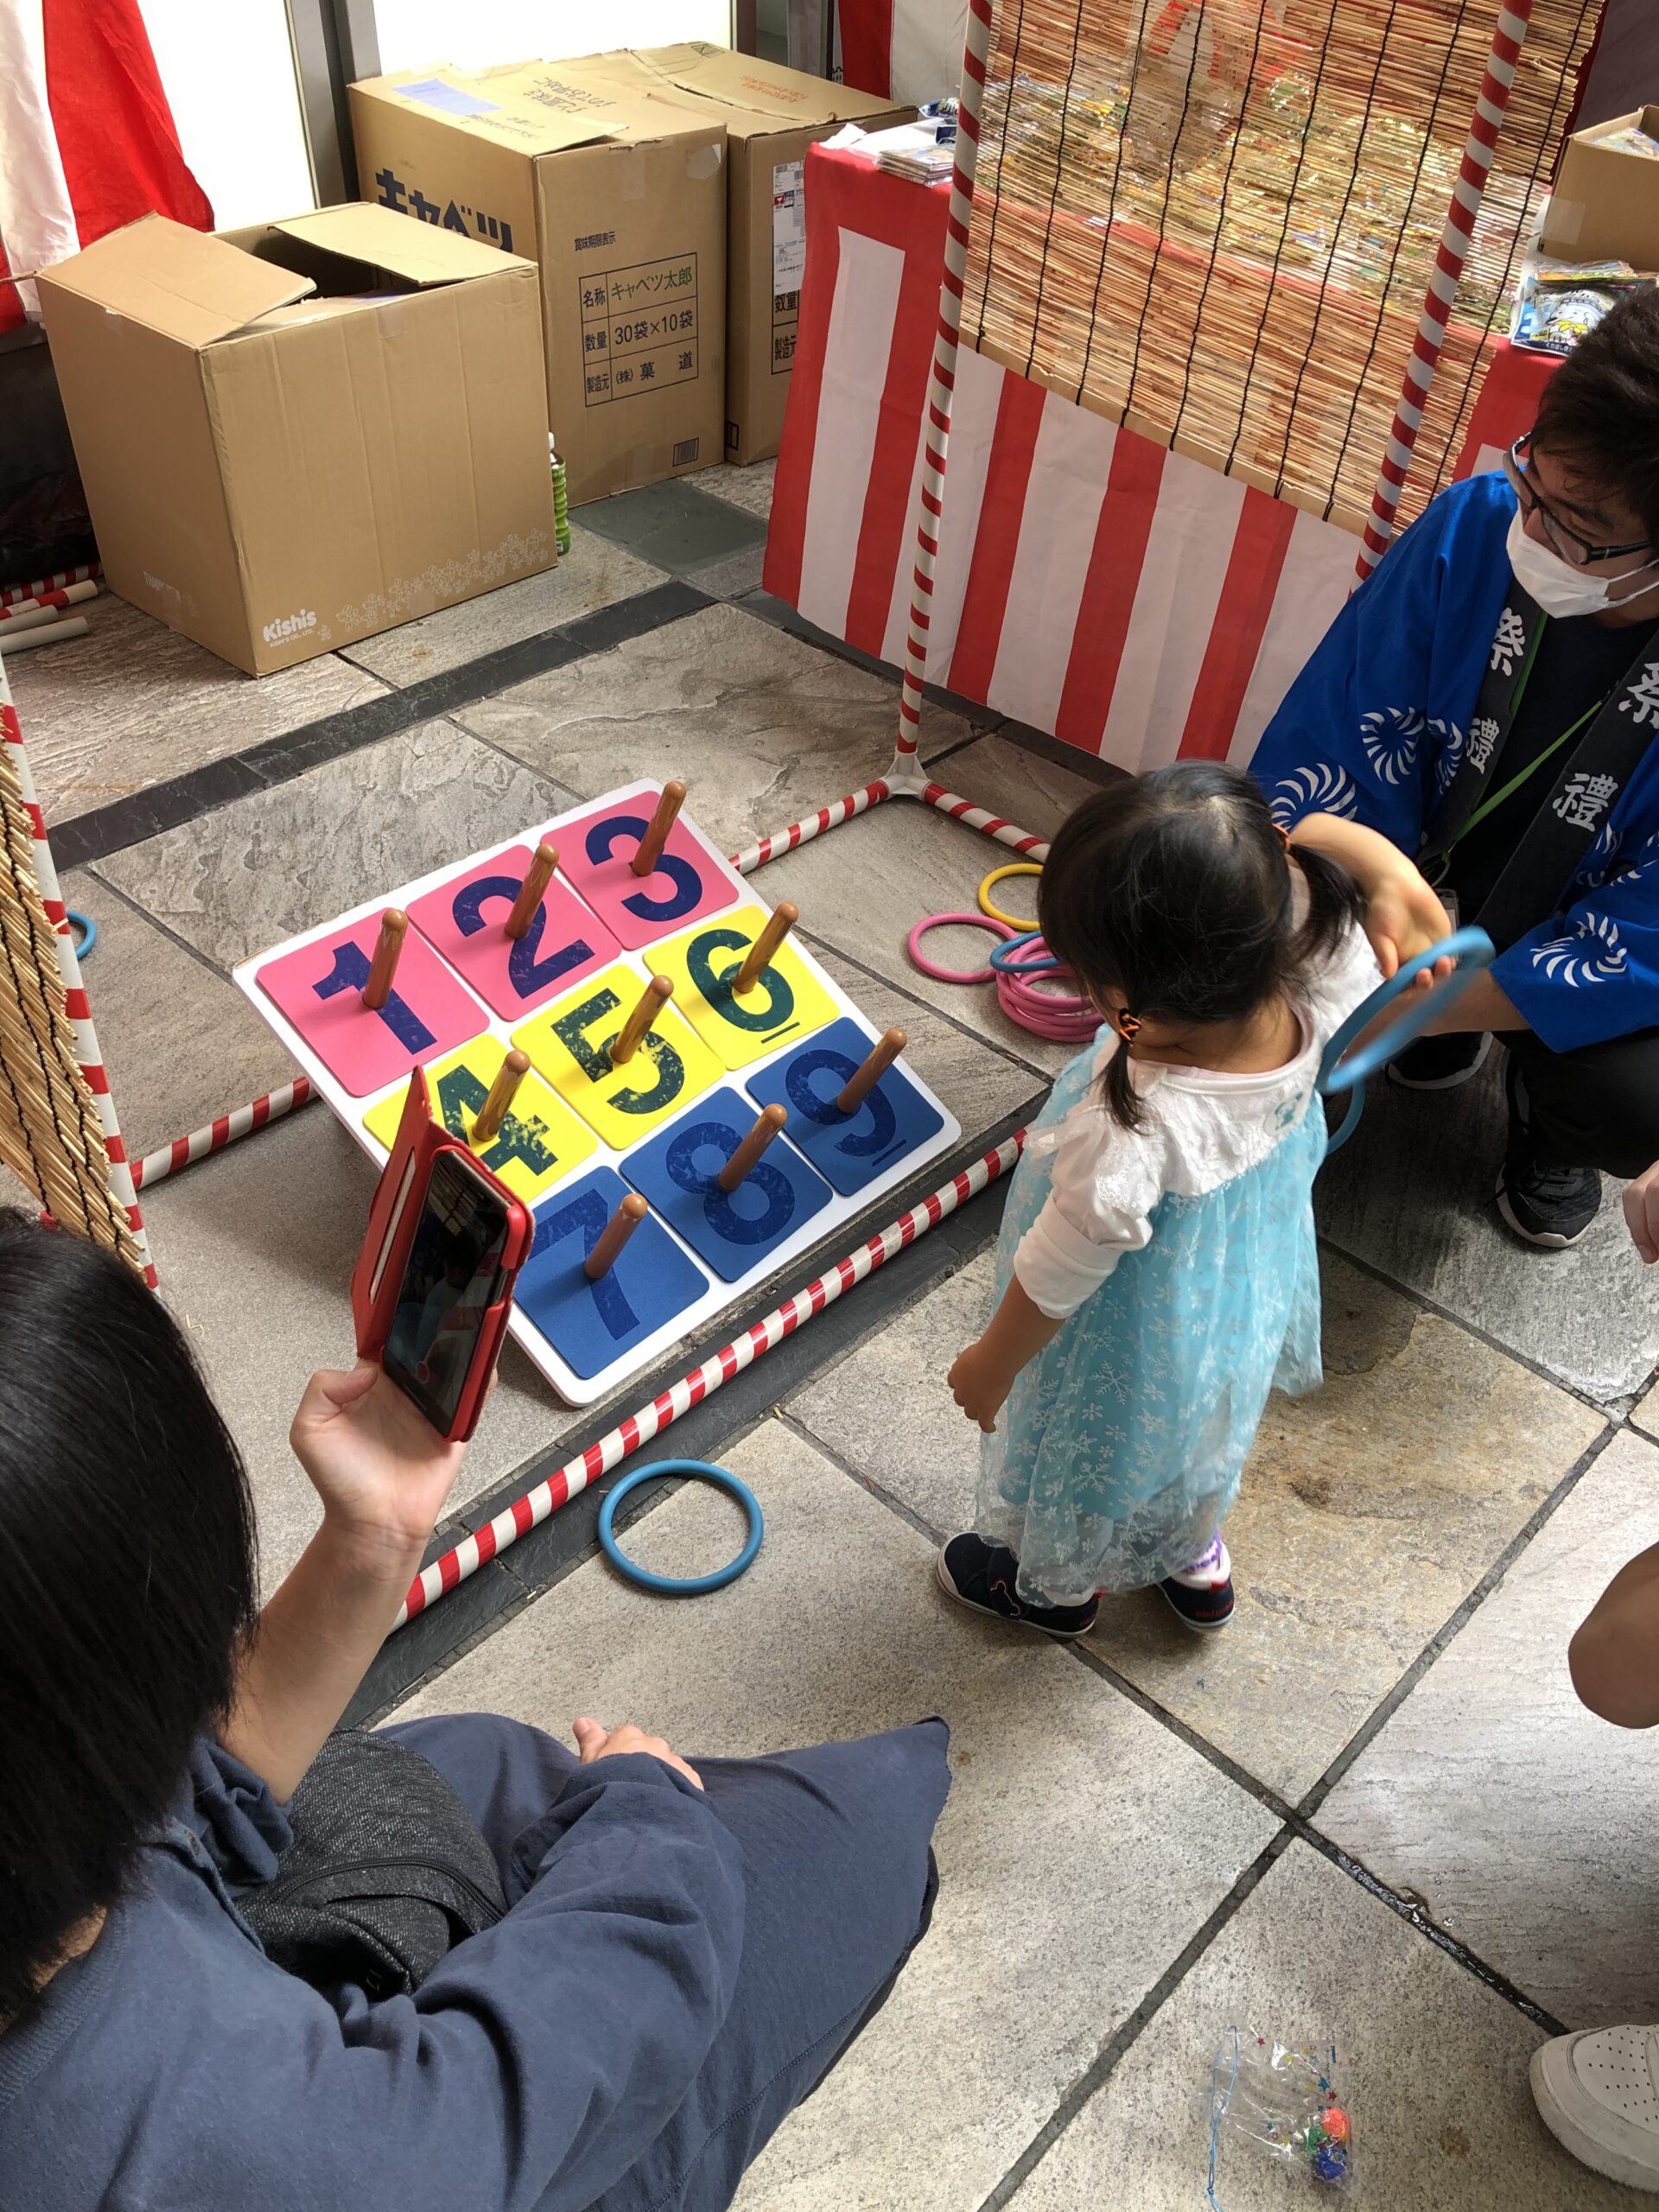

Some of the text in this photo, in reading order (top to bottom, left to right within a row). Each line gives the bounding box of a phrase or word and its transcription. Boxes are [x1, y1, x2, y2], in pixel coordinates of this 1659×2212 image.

[583, 287, 607, 308] 名称
[611, 266, 693, 301] キャベツ太郎
[614, 309, 693, 346] 30袋×10袋
[585, 331, 607, 353] 数量
[587, 373, 610, 394] 製造元
[263, 608, 317, 642] Kishis
[585, 815, 702, 922] 3
[451, 875, 595, 1000] 2
[686, 928, 795, 1033] 6
[312, 940, 438, 1055] 1
[550, 988, 685, 1115] 5
[785, 1048, 896, 1156] 9
[436, 1064, 558, 1177] 4
[665, 1121, 795, 1245] 8
[529, 1190, 640, 1340] 7
